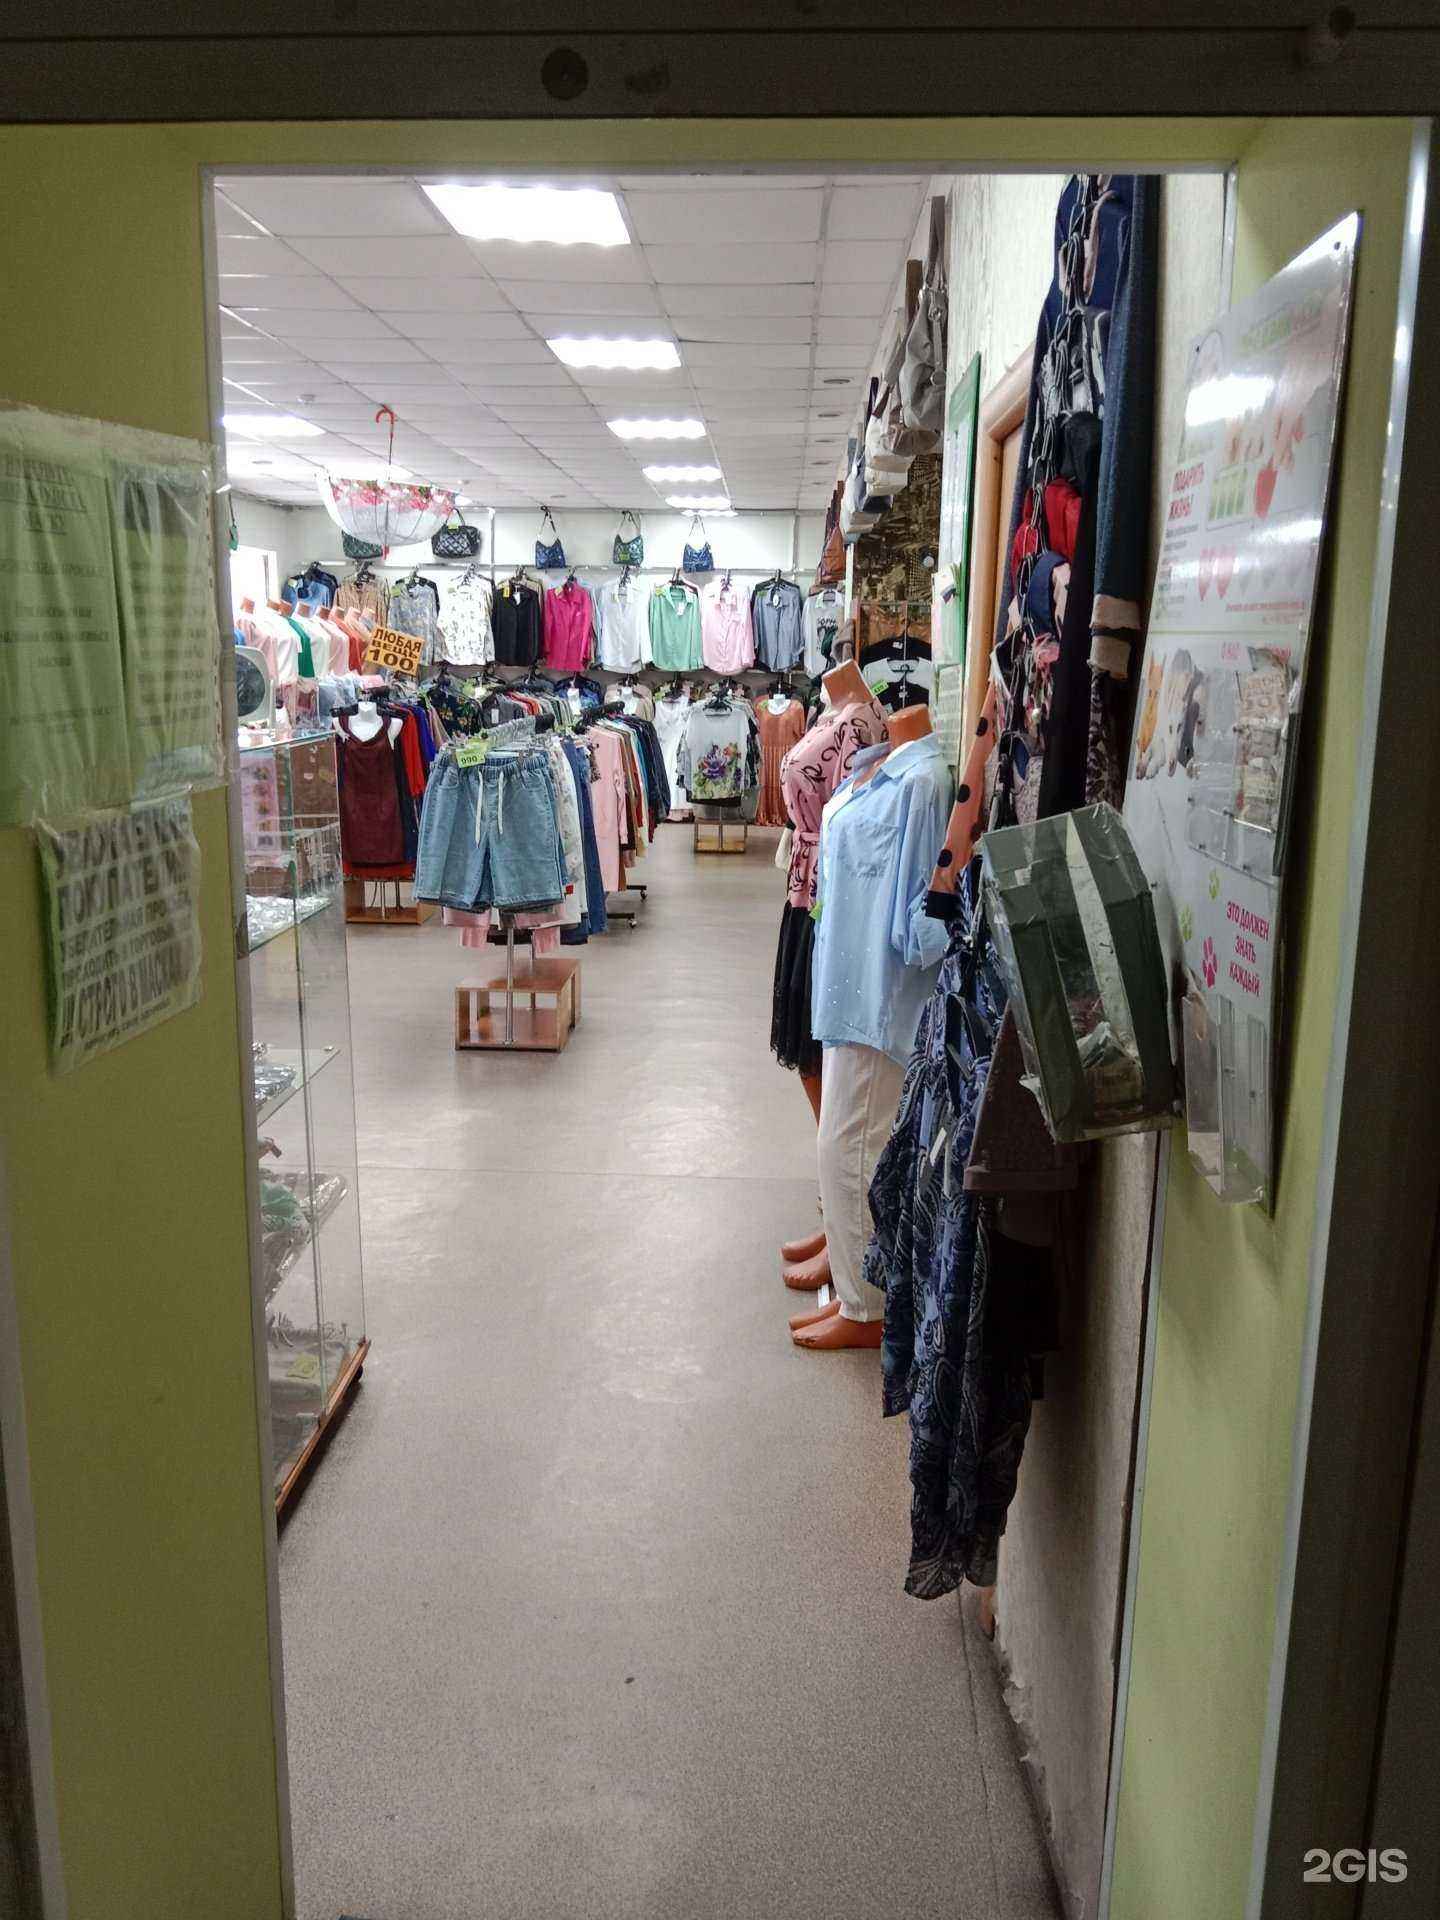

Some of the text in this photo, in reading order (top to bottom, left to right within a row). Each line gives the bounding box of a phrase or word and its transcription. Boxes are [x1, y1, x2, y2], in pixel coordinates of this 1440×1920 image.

[372, 640, 418, 659] ВЕЩЬ
[374, 629, 422, 653] ЛЮБАЯ
[369, 649, 414, 671] 100
[1227, 901, 1270, 941] ЭТО ДОЛЖЕН
[1235, 935, 1257, 964] ЗНАТЬ
[1229, 960, 1261, 997] КАЖДЫЙ
